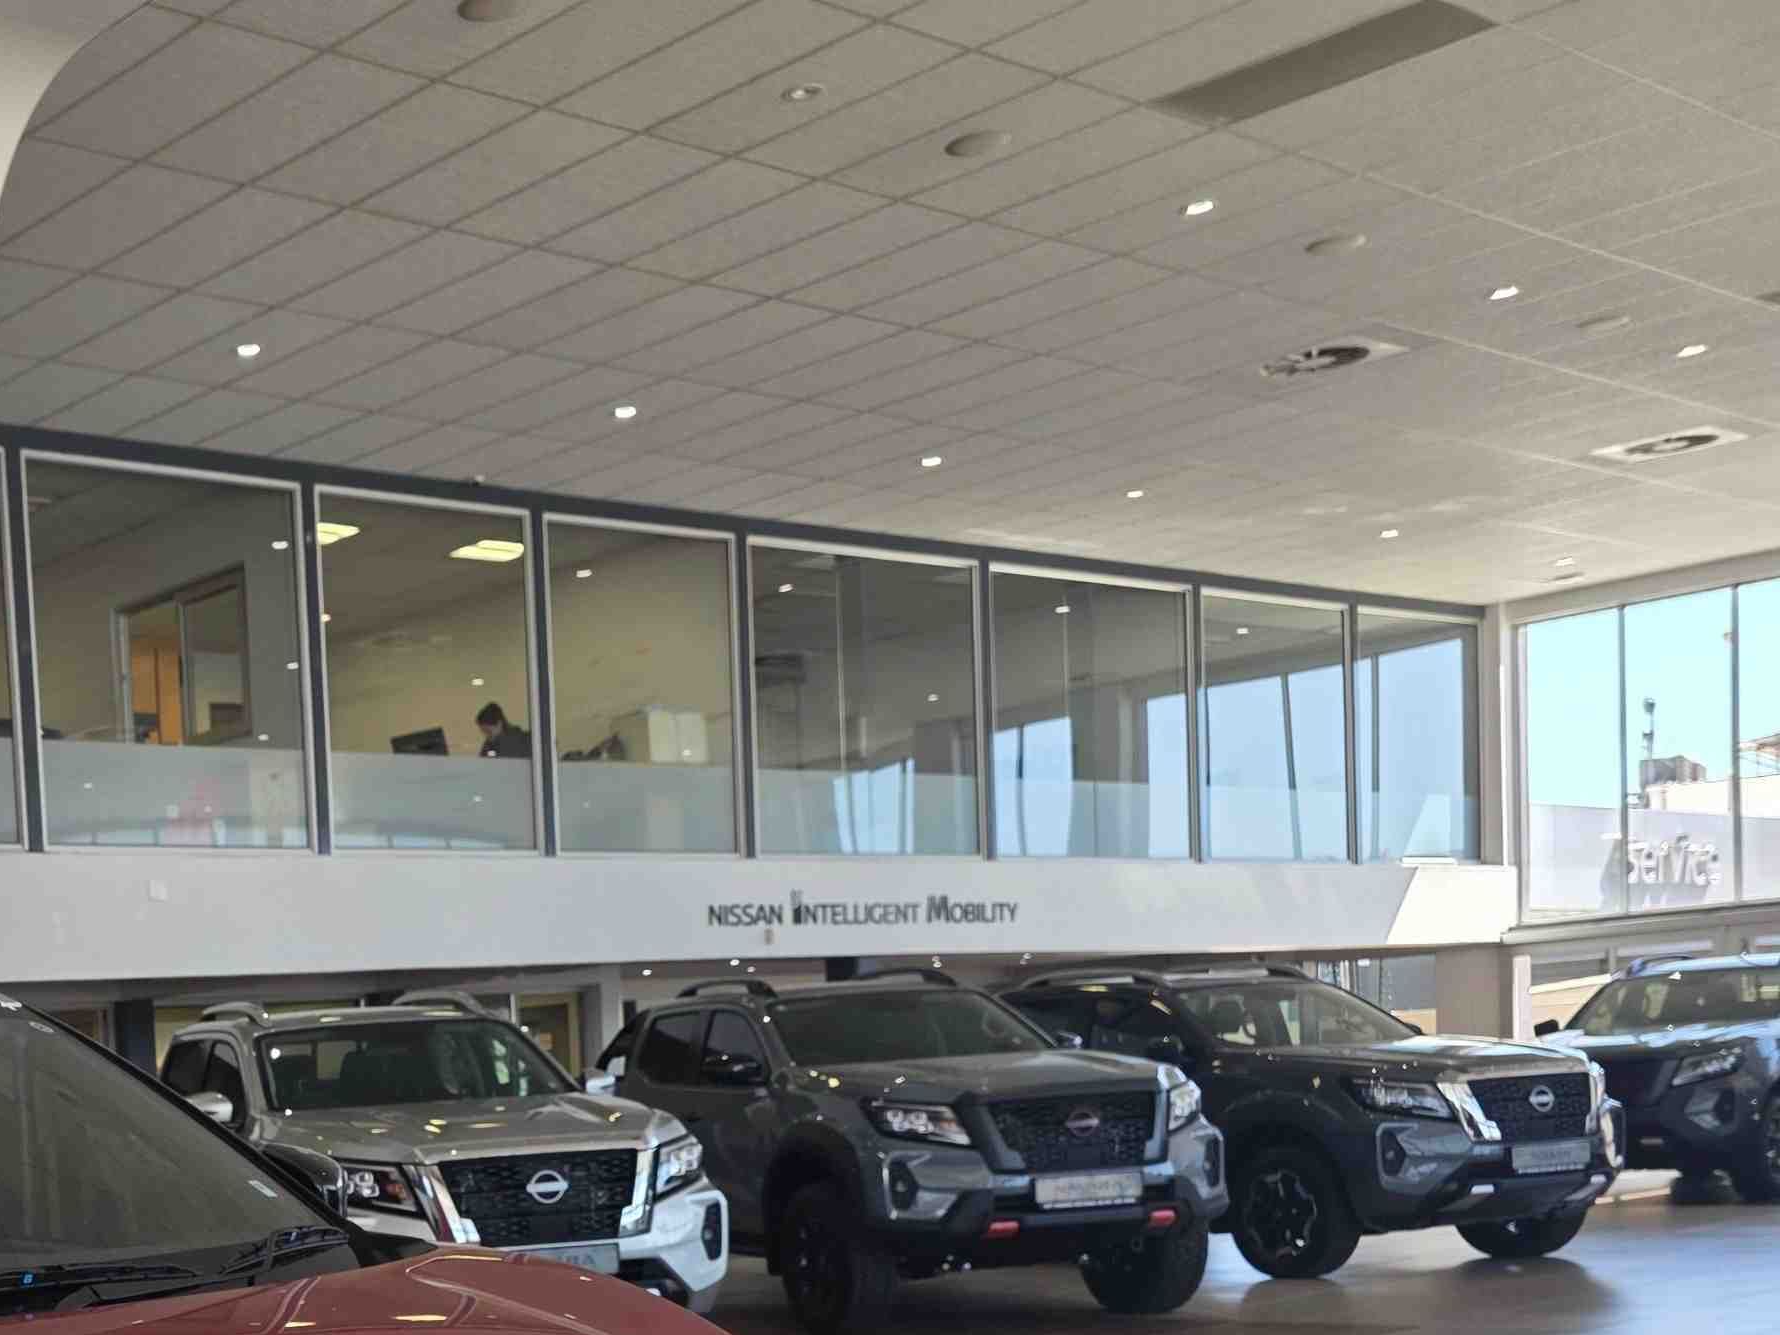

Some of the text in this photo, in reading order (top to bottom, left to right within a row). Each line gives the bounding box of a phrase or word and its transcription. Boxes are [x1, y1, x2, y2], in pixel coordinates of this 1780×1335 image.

[708, 891, 1017, 926] NISSAN INTELLIGENT MOBILITY
